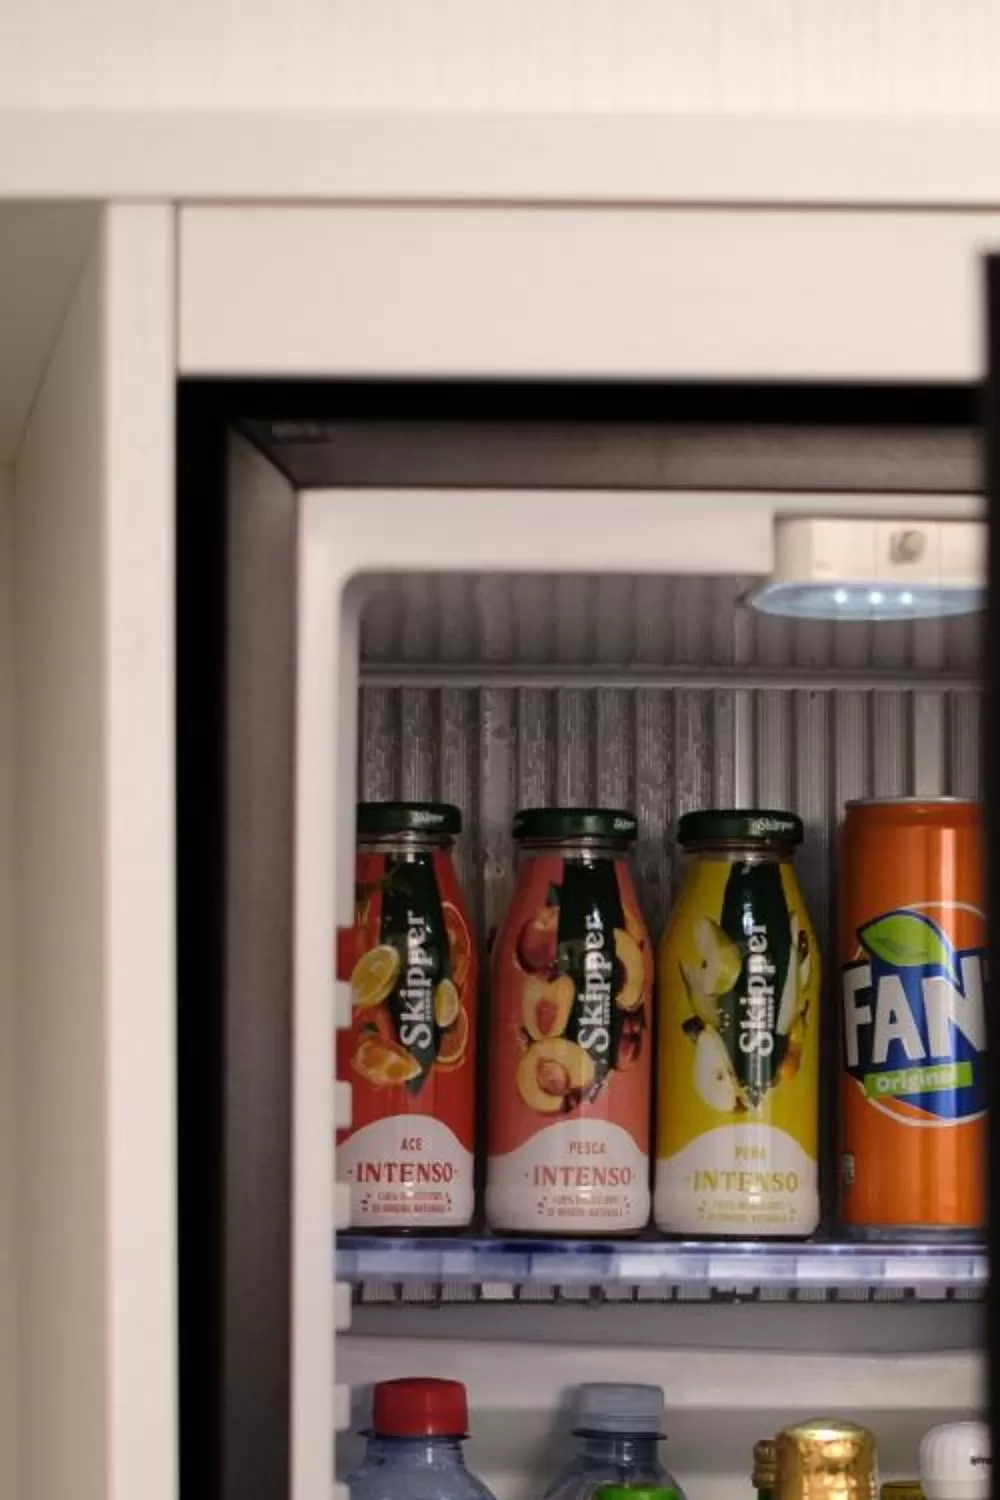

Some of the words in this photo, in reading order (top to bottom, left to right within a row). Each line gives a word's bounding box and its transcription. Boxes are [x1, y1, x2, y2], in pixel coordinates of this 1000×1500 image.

[399, 909, 433, 1049] Skipper
[577, 912, 612, 1050] Skipper
[739, 924, 775, 1056] Skipper
[843, 955, 988, 1067] FAN
[875, 1067, 960, 1094] Original
[400, 1137, 423, 1151] ACE
[356, 1162, 453, 1184] INTENSO
[533, 1165, 632, 1187] INTENSO
[694, 1170, 799, 1193] INTENSO
